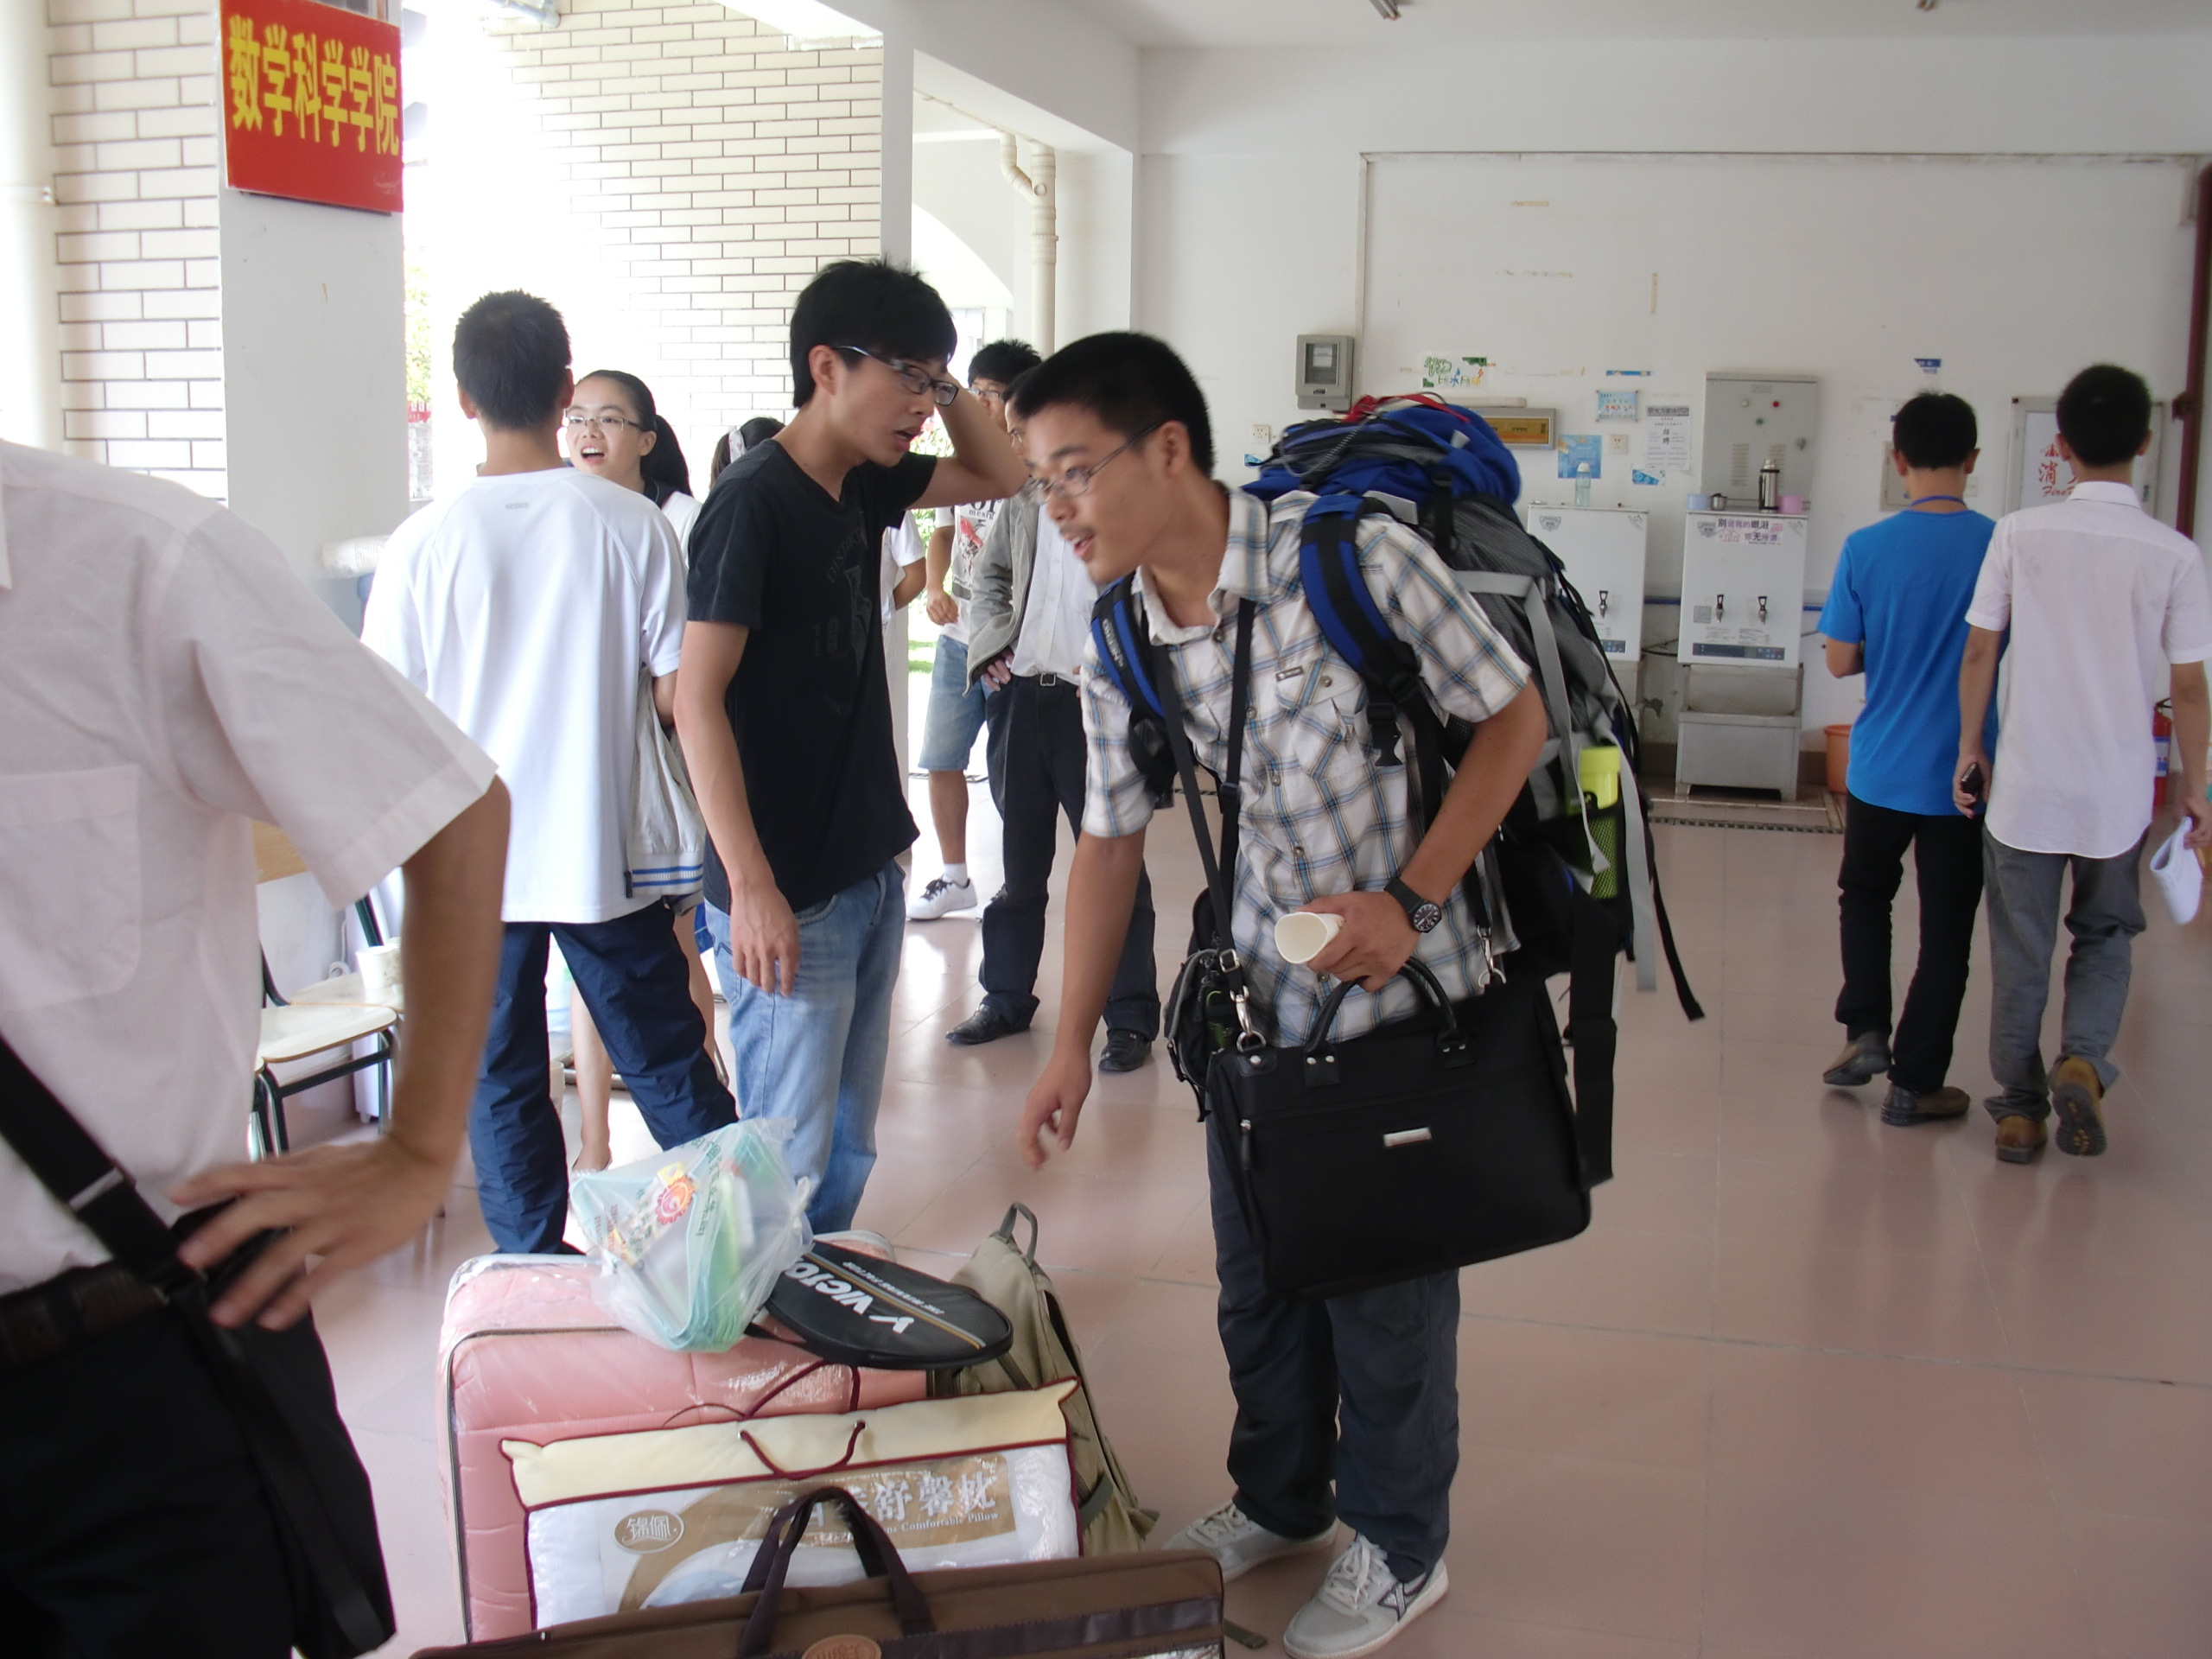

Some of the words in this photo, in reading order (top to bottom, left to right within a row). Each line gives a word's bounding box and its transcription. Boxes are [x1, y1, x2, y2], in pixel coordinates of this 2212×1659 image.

[228, 14, 400, 156] 数学科学学院
[785, 1259, 873, 1314] VICTO
[901, 1515, 963, 1532] Comfortable
[968, 1512, 999, 1523] Pillow
